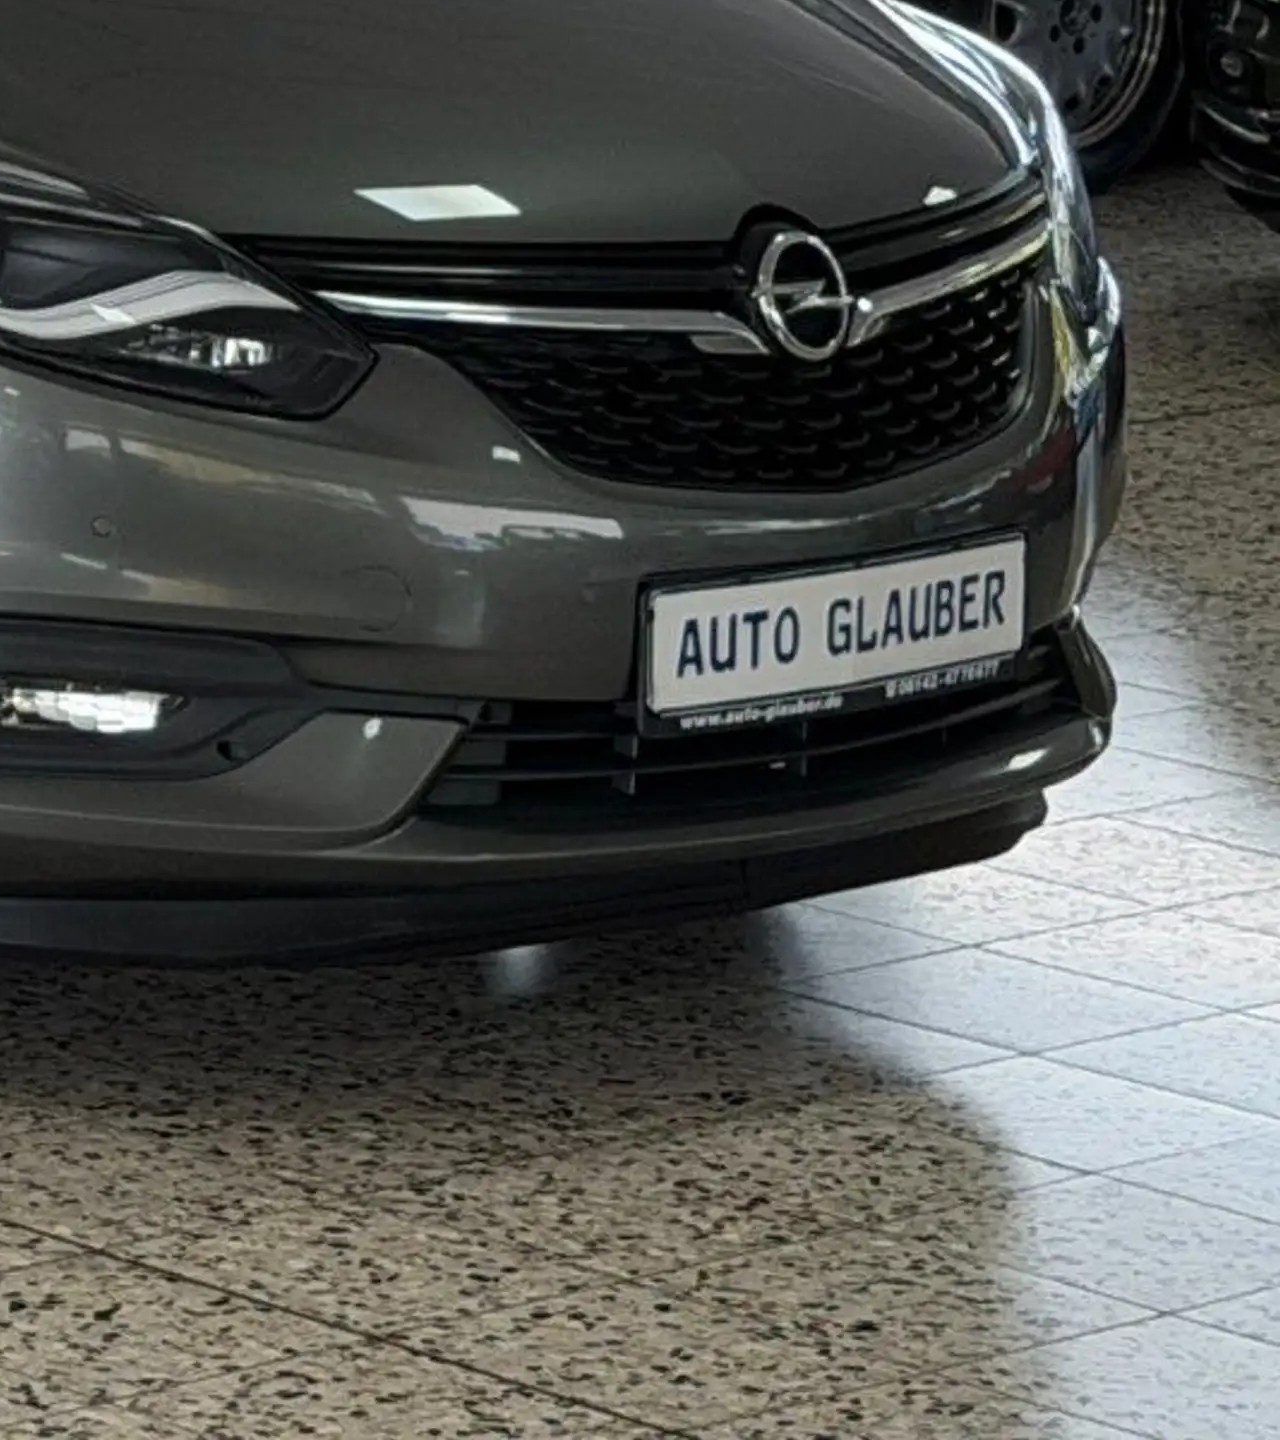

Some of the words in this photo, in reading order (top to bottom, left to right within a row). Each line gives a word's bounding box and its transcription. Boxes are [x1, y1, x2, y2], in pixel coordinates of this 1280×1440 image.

[676, 606, 800, 679] AUTO
[827, 569, 1006, 657] GLAUBER
[679, 692, 843, 729] www.auto-glauber.de
